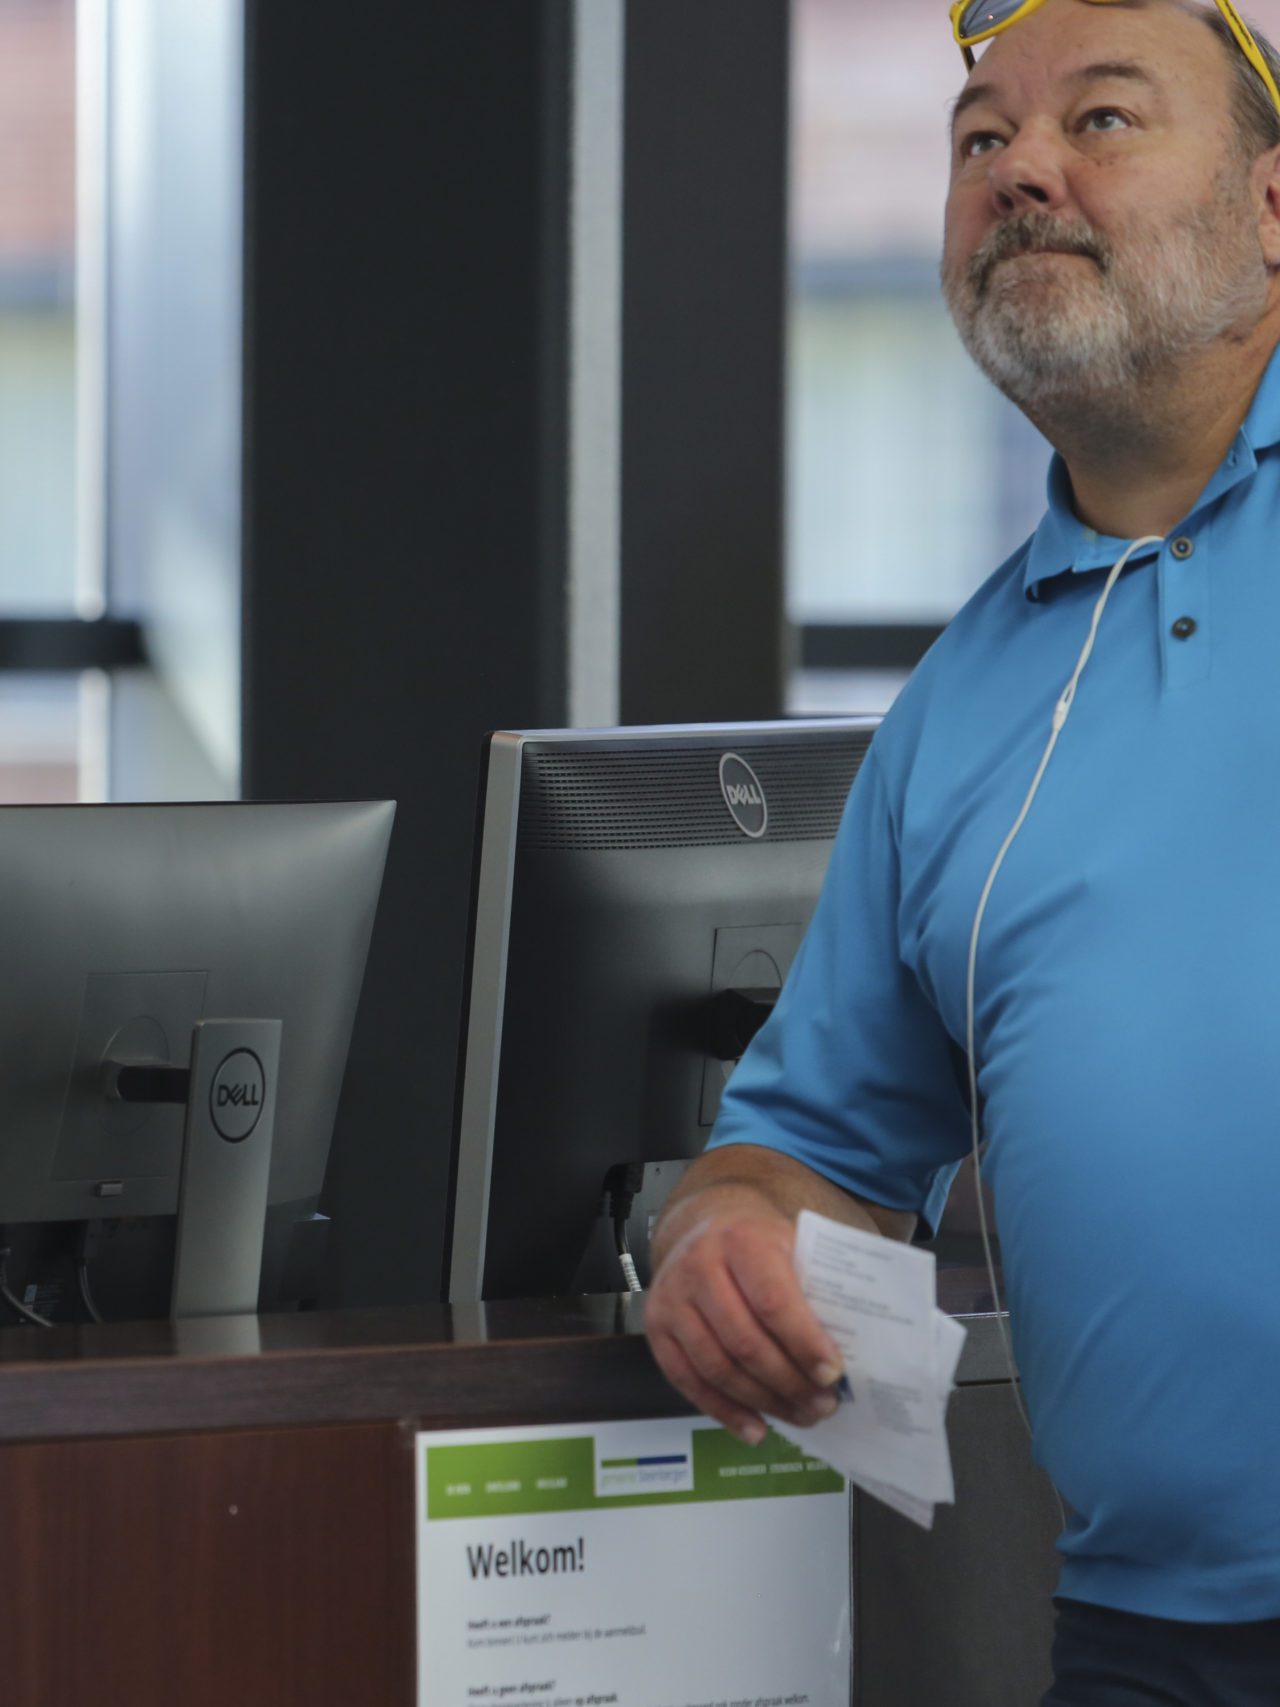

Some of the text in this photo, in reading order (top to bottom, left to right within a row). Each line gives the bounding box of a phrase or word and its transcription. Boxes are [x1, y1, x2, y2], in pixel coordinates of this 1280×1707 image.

[726, 784, 761, 806] DELL
[218, 1083, 259, 1107] DELL
[466, 1537, 585, 1579] Welkom!
